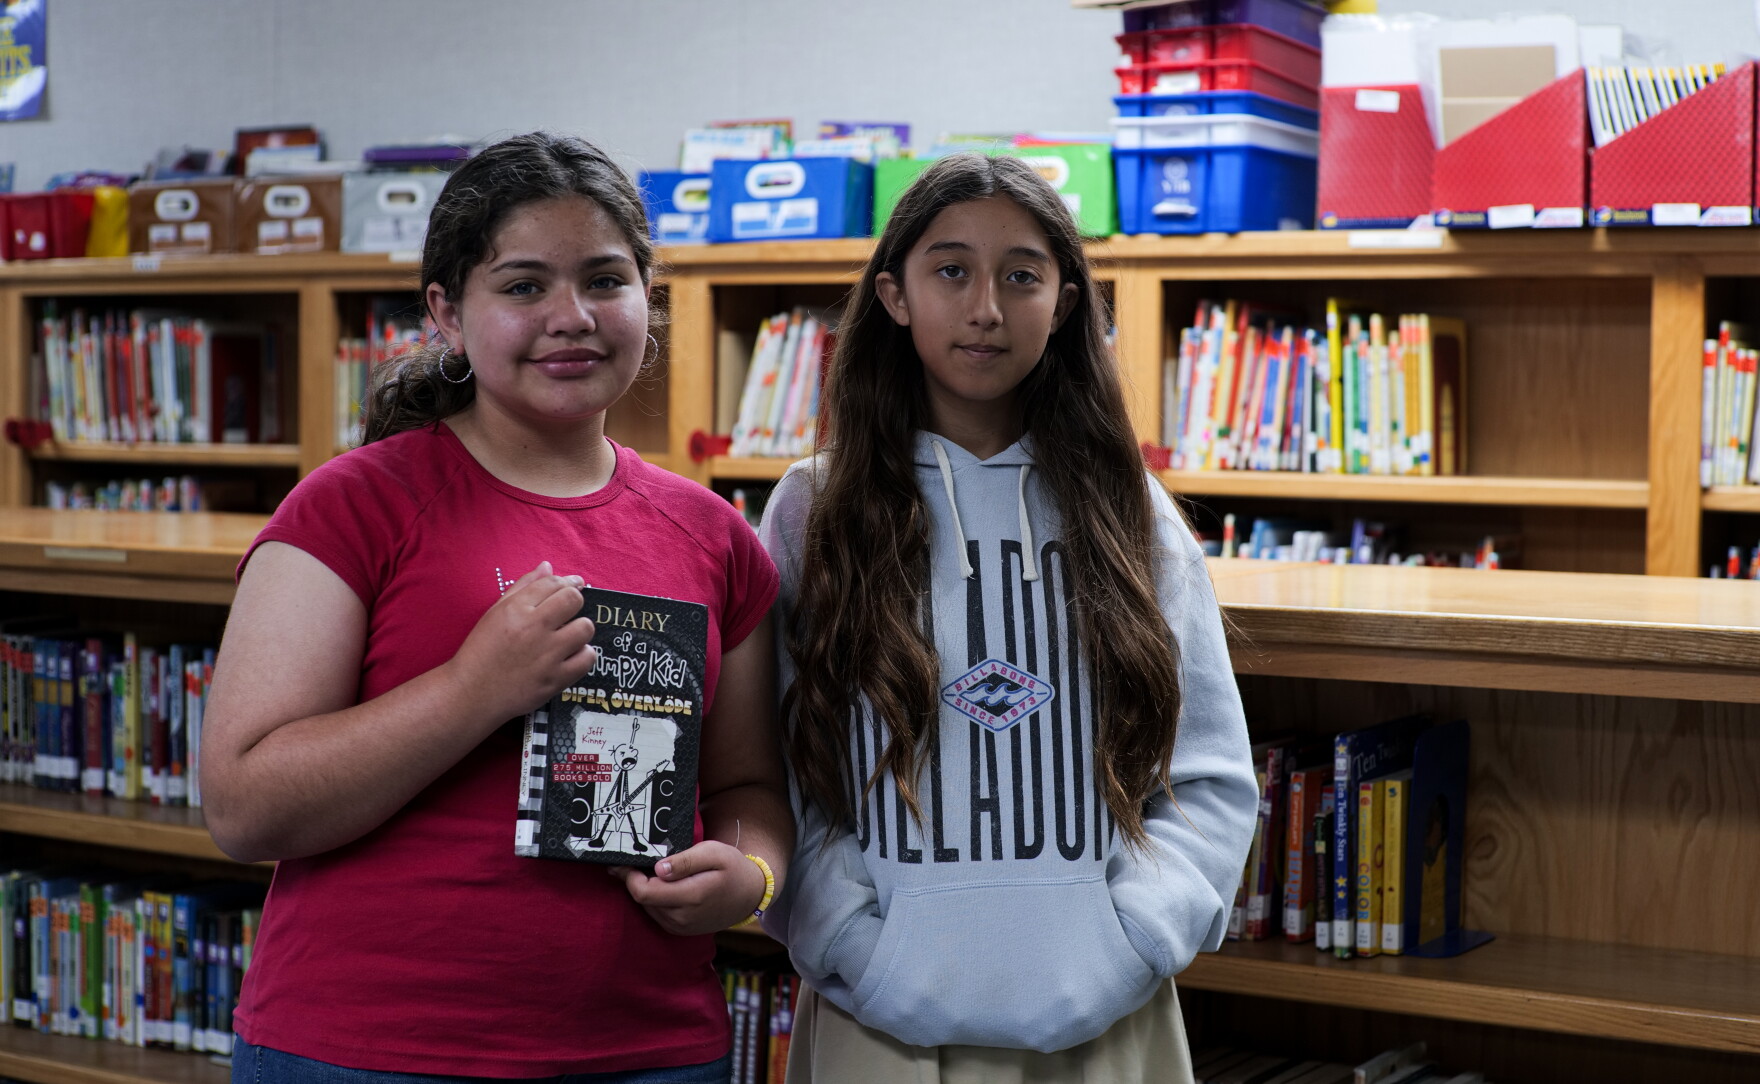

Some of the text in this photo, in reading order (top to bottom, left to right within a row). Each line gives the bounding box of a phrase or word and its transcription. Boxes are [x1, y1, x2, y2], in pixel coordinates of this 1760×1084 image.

[595, 604, 671, 633] DIARY
[613, 631, 647, 654] of a
[587, 646, 687, 689] impy Kid
[954, 663, 1036, 692] BILLABONG
[561, 687, 693, 716] DIPER ÖVERLÖDE
[955, 696, 1037, 725] SINCE 1973
[581, 735, 607, 750] Kinney
[587, 726, 604, 736] Jeff
[1354, 752, 1377, 779] Ten
[1334, 781, 1347, 862] Ten Twinkly Stars
[1358, 863, 1370, 920] COLOR
